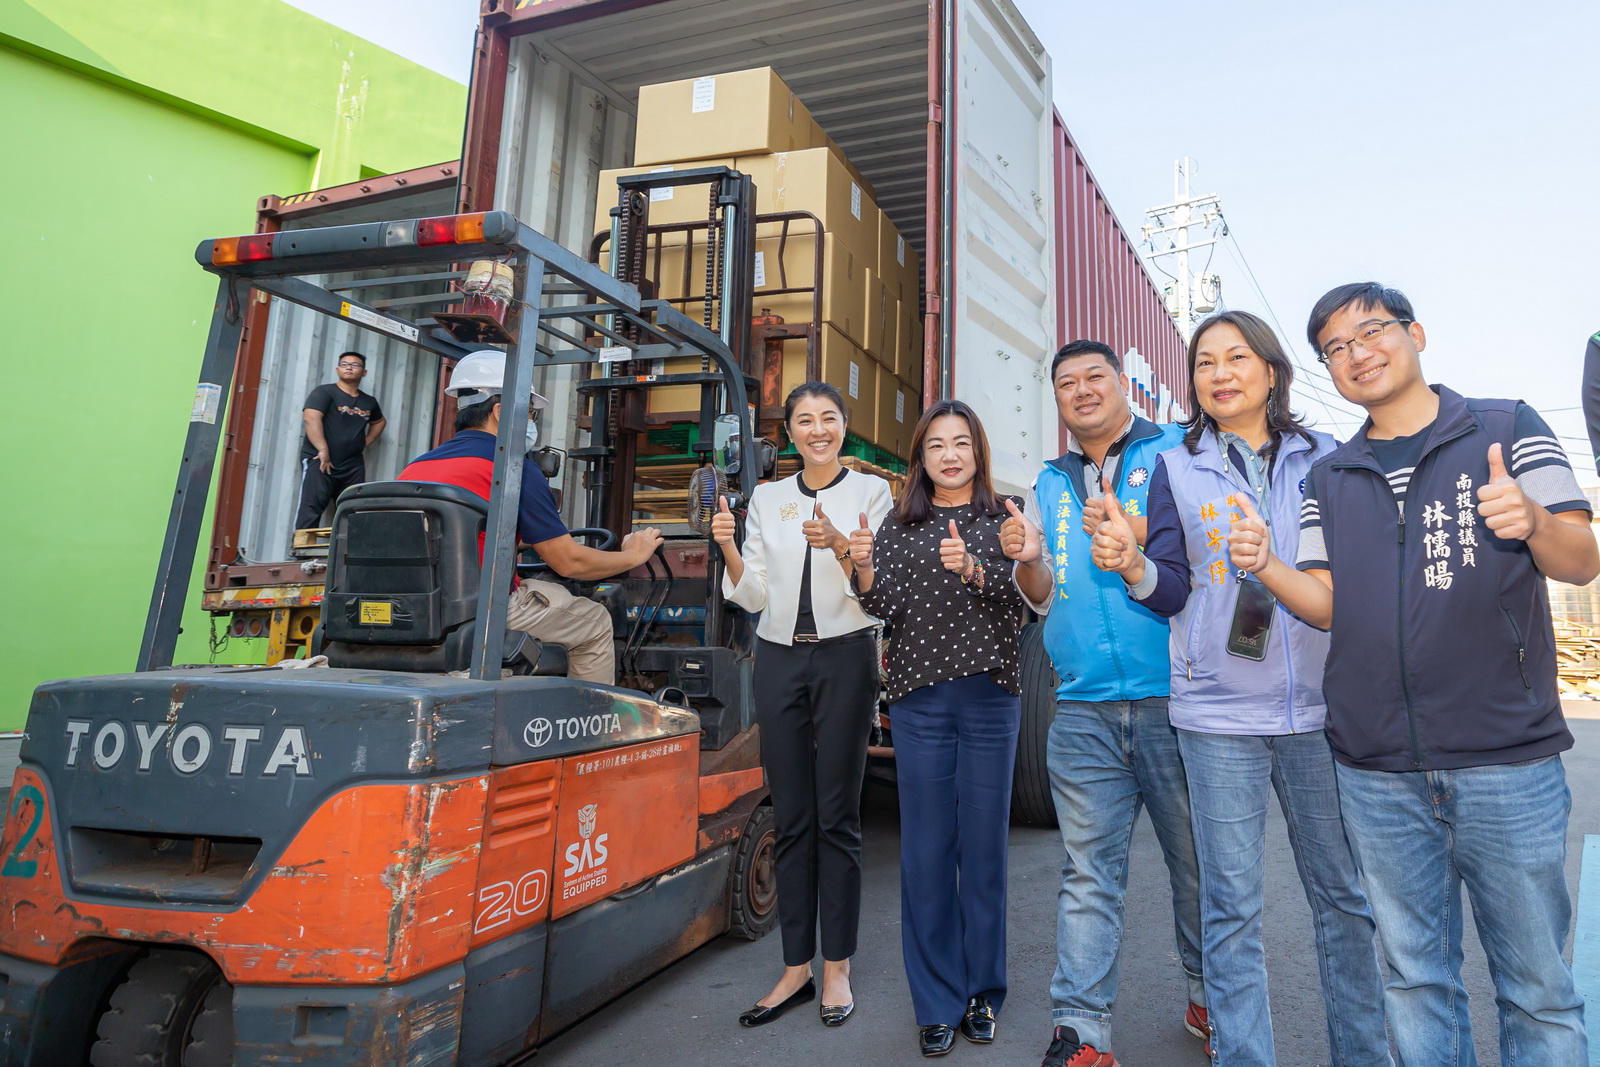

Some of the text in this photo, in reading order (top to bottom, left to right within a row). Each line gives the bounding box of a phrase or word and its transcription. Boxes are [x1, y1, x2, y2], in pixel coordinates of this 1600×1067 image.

[1055, 491, 1072, 602] 立法委員候選人
[1421, 500, 1454, 591] 林儒暘
[1455, 473, 1479, 568] 南投縣議員
[65, 721, 311, 775] TOYOTA
[556, 713, 621, 741] TOYOTA
[2, 784, 45, 878] 2
[564, 832, 608, 878] SAS
[473, 868, 548, 935] 20
[563, 874, 608, 900] EQUIPPED
